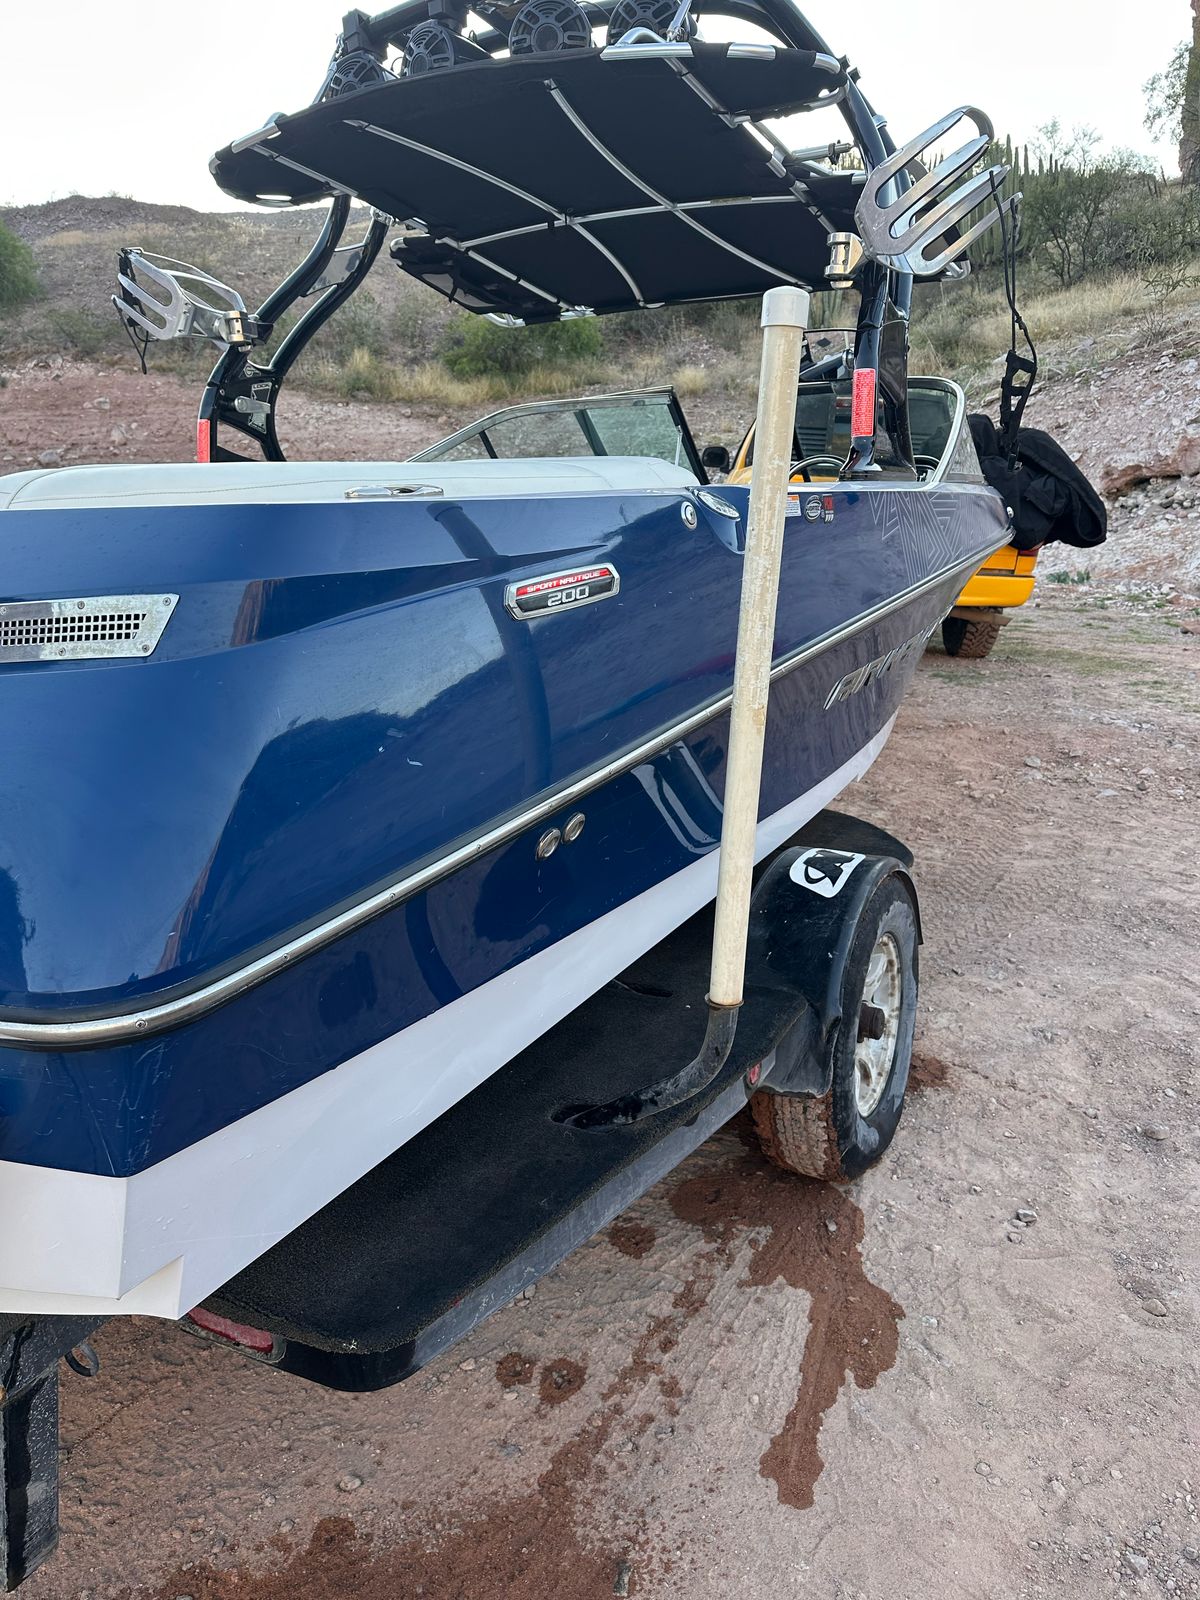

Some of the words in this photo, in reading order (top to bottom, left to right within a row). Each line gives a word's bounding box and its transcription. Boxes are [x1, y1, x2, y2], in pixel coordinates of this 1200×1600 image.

[527, 580, 559, 593] SPORT
[559, 571, 601, 585] NAUTIQUE
[547, 585, 590, 607] 200
